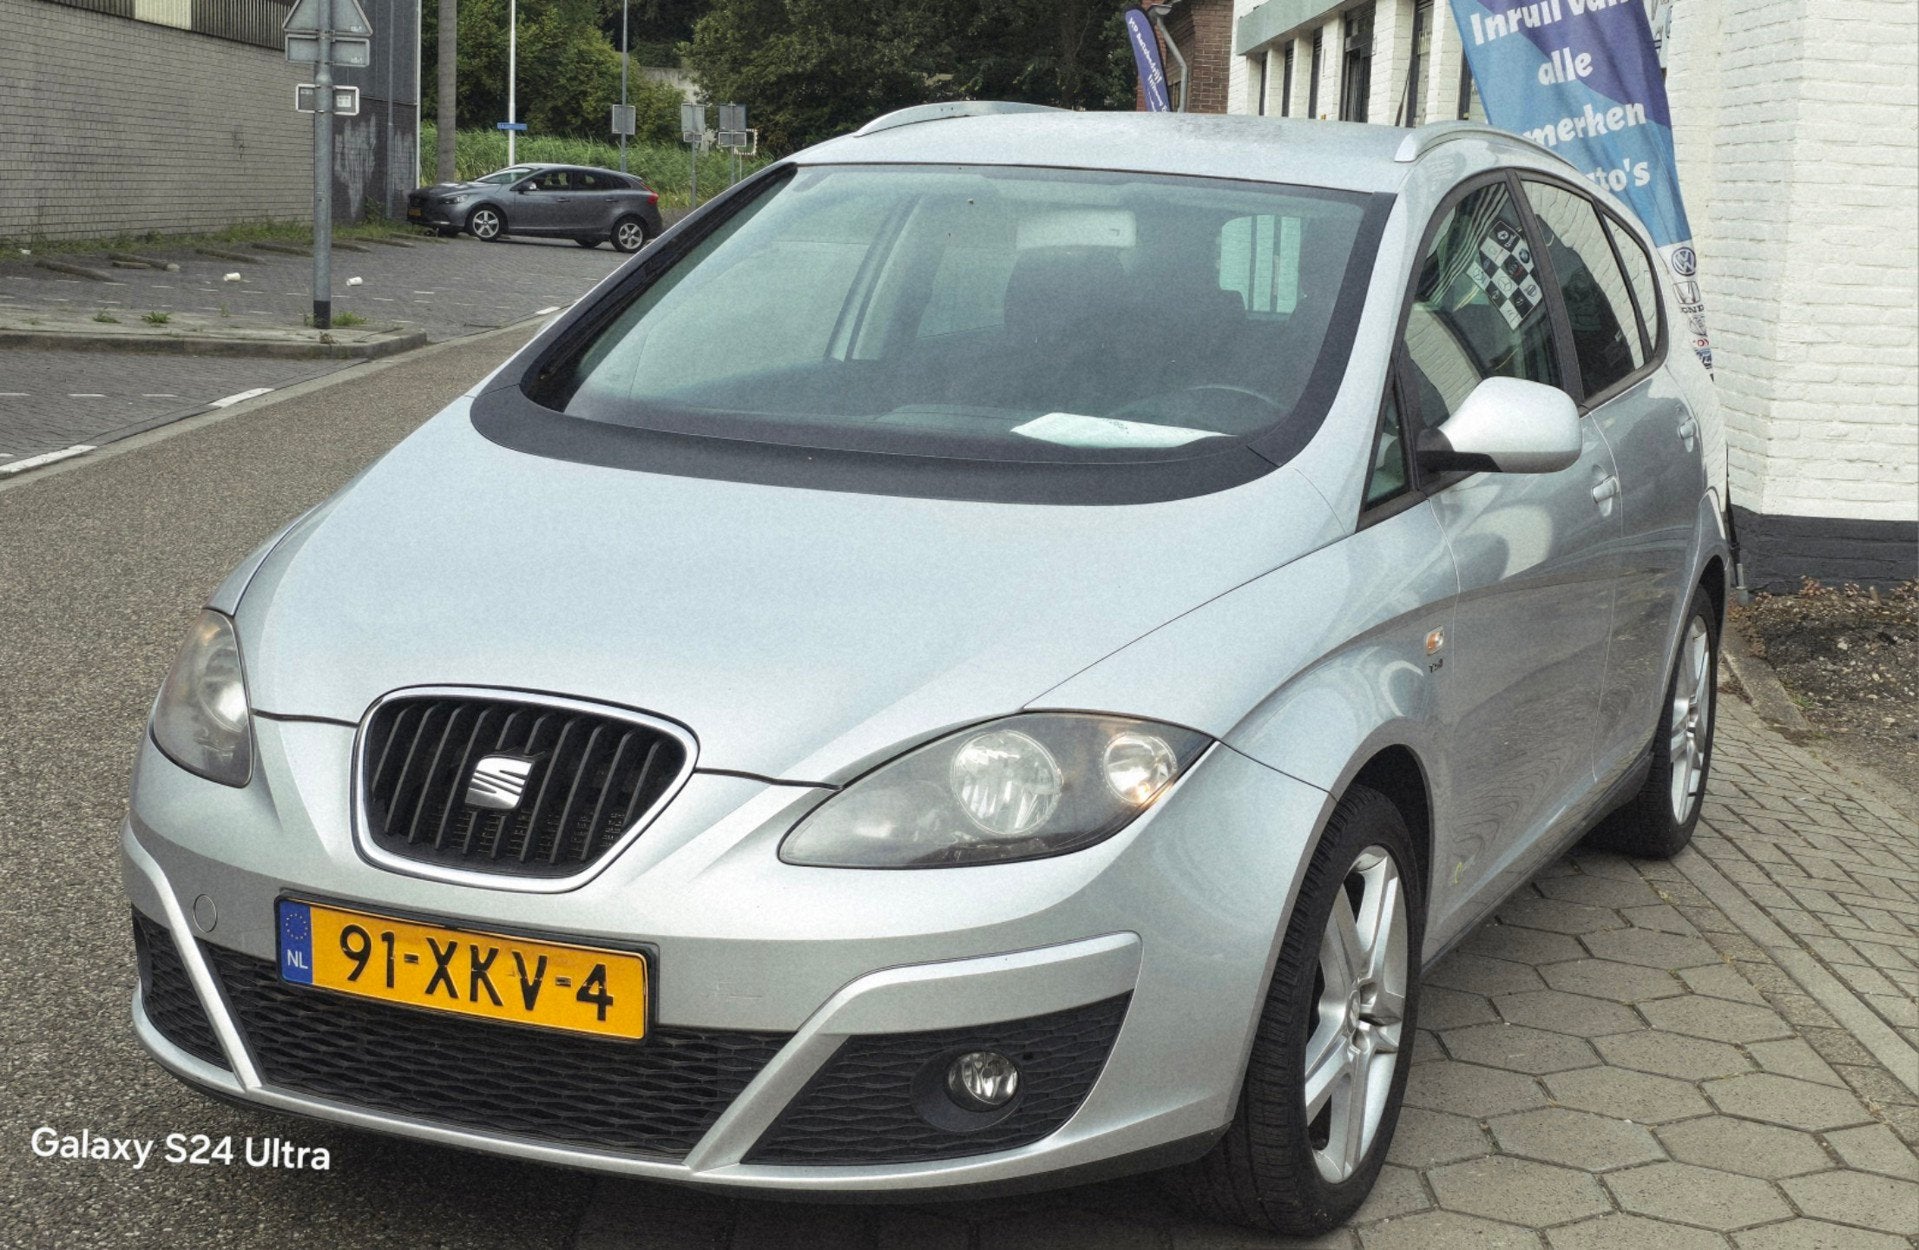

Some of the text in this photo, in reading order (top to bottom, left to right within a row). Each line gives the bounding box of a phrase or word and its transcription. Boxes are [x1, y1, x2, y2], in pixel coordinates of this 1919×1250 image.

[1470, 0, 1563, 46] Inruil
[1537, 47, 1594, 86] alle
[1522, 102, 1647, 147] merken
[1585, 157, 1651, 192] to's
[286, 923, 615, 1022] NL 91-XKV-4
